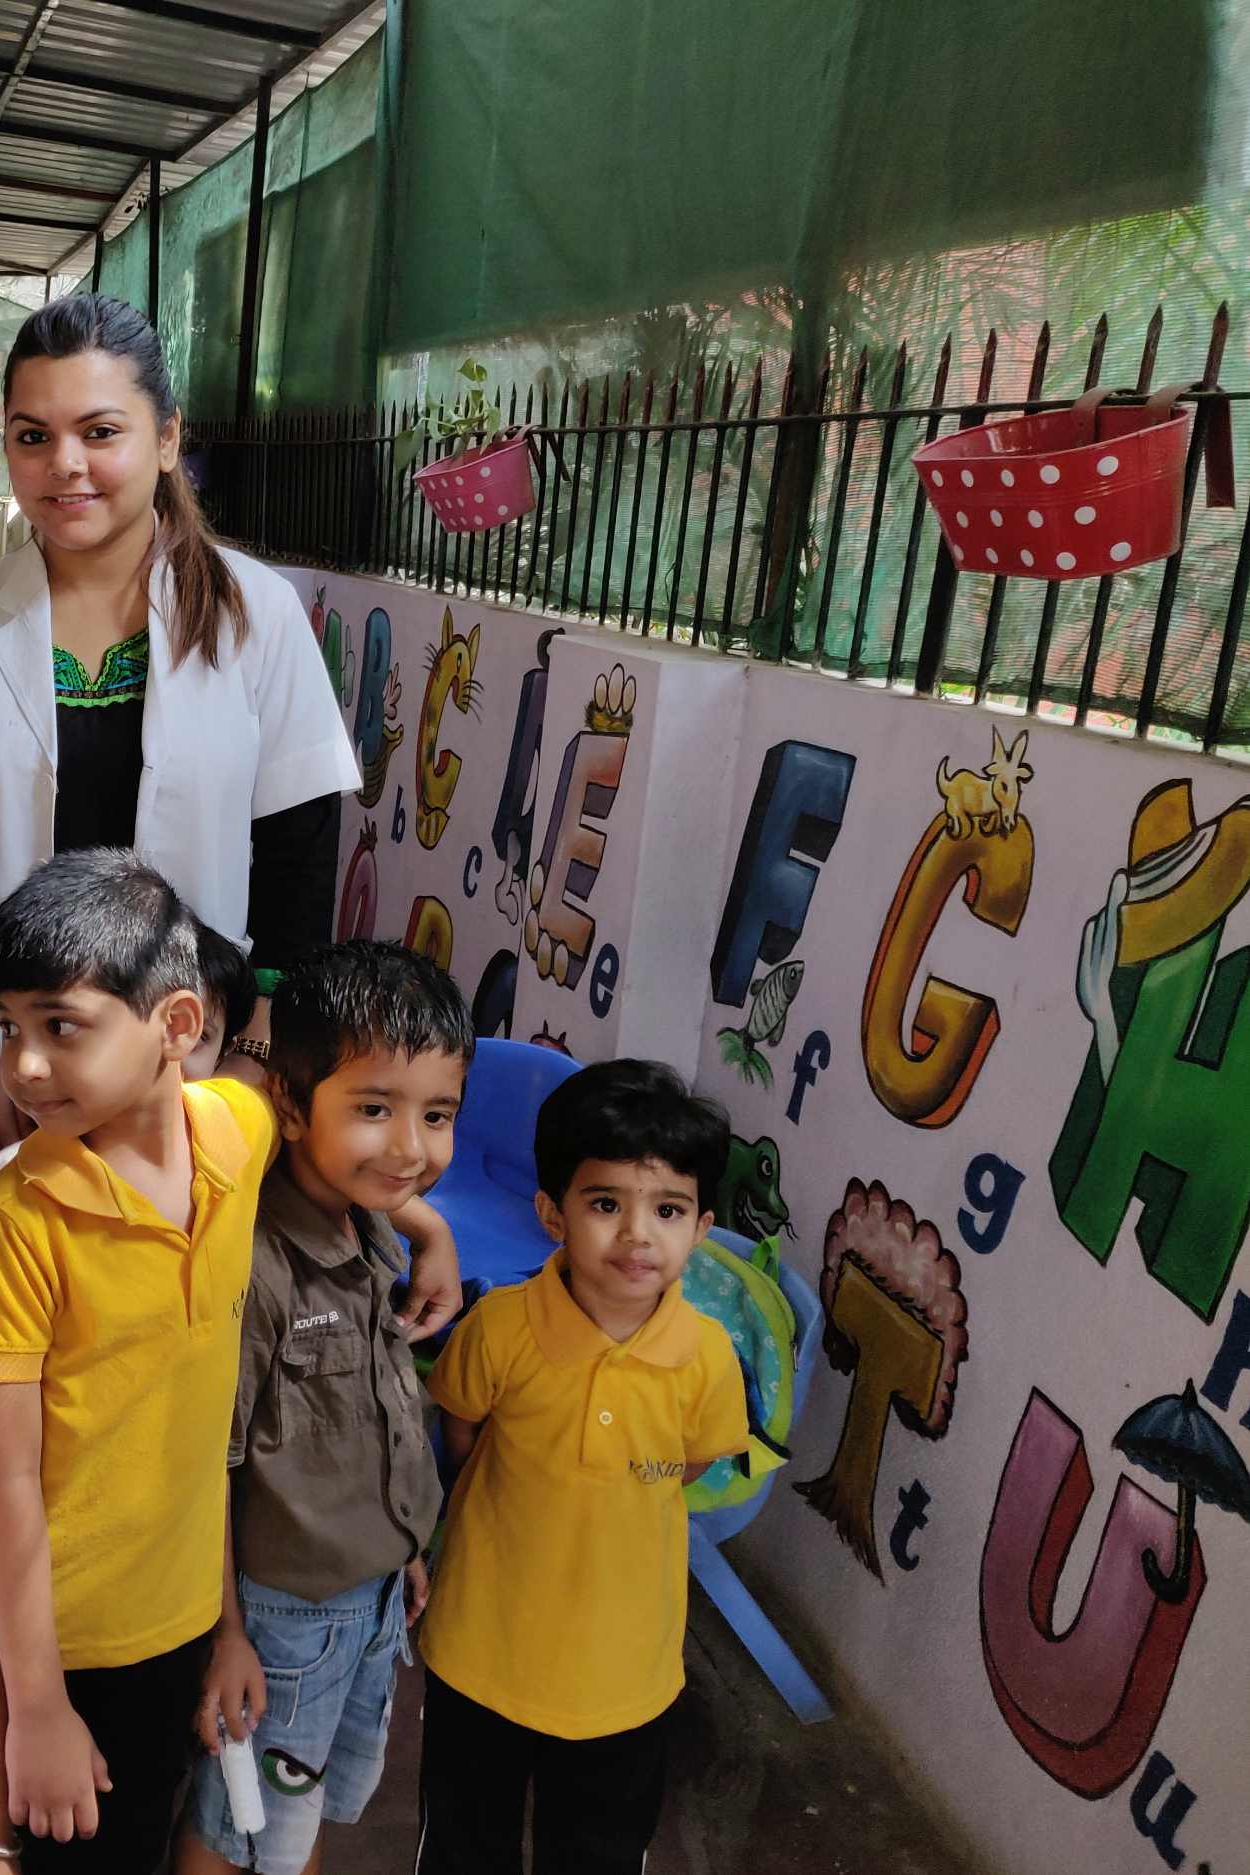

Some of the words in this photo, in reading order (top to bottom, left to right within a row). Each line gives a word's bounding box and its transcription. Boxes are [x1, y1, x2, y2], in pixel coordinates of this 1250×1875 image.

[391, 785, 406, 844] b
[589, 943, 620, 1019] e
[785, 1029, 831, 1126] f
[958, 1152, 1027, 1255] g
[533, 730, 630, 990] E
[710, 739, 857, 1009] F
[861, 811, 1035, 1130] G
[890, 1478, 931, 1571] t
[1130, 1750, 1197, 1872] u
[979, 1385, 1208, 1801] U
